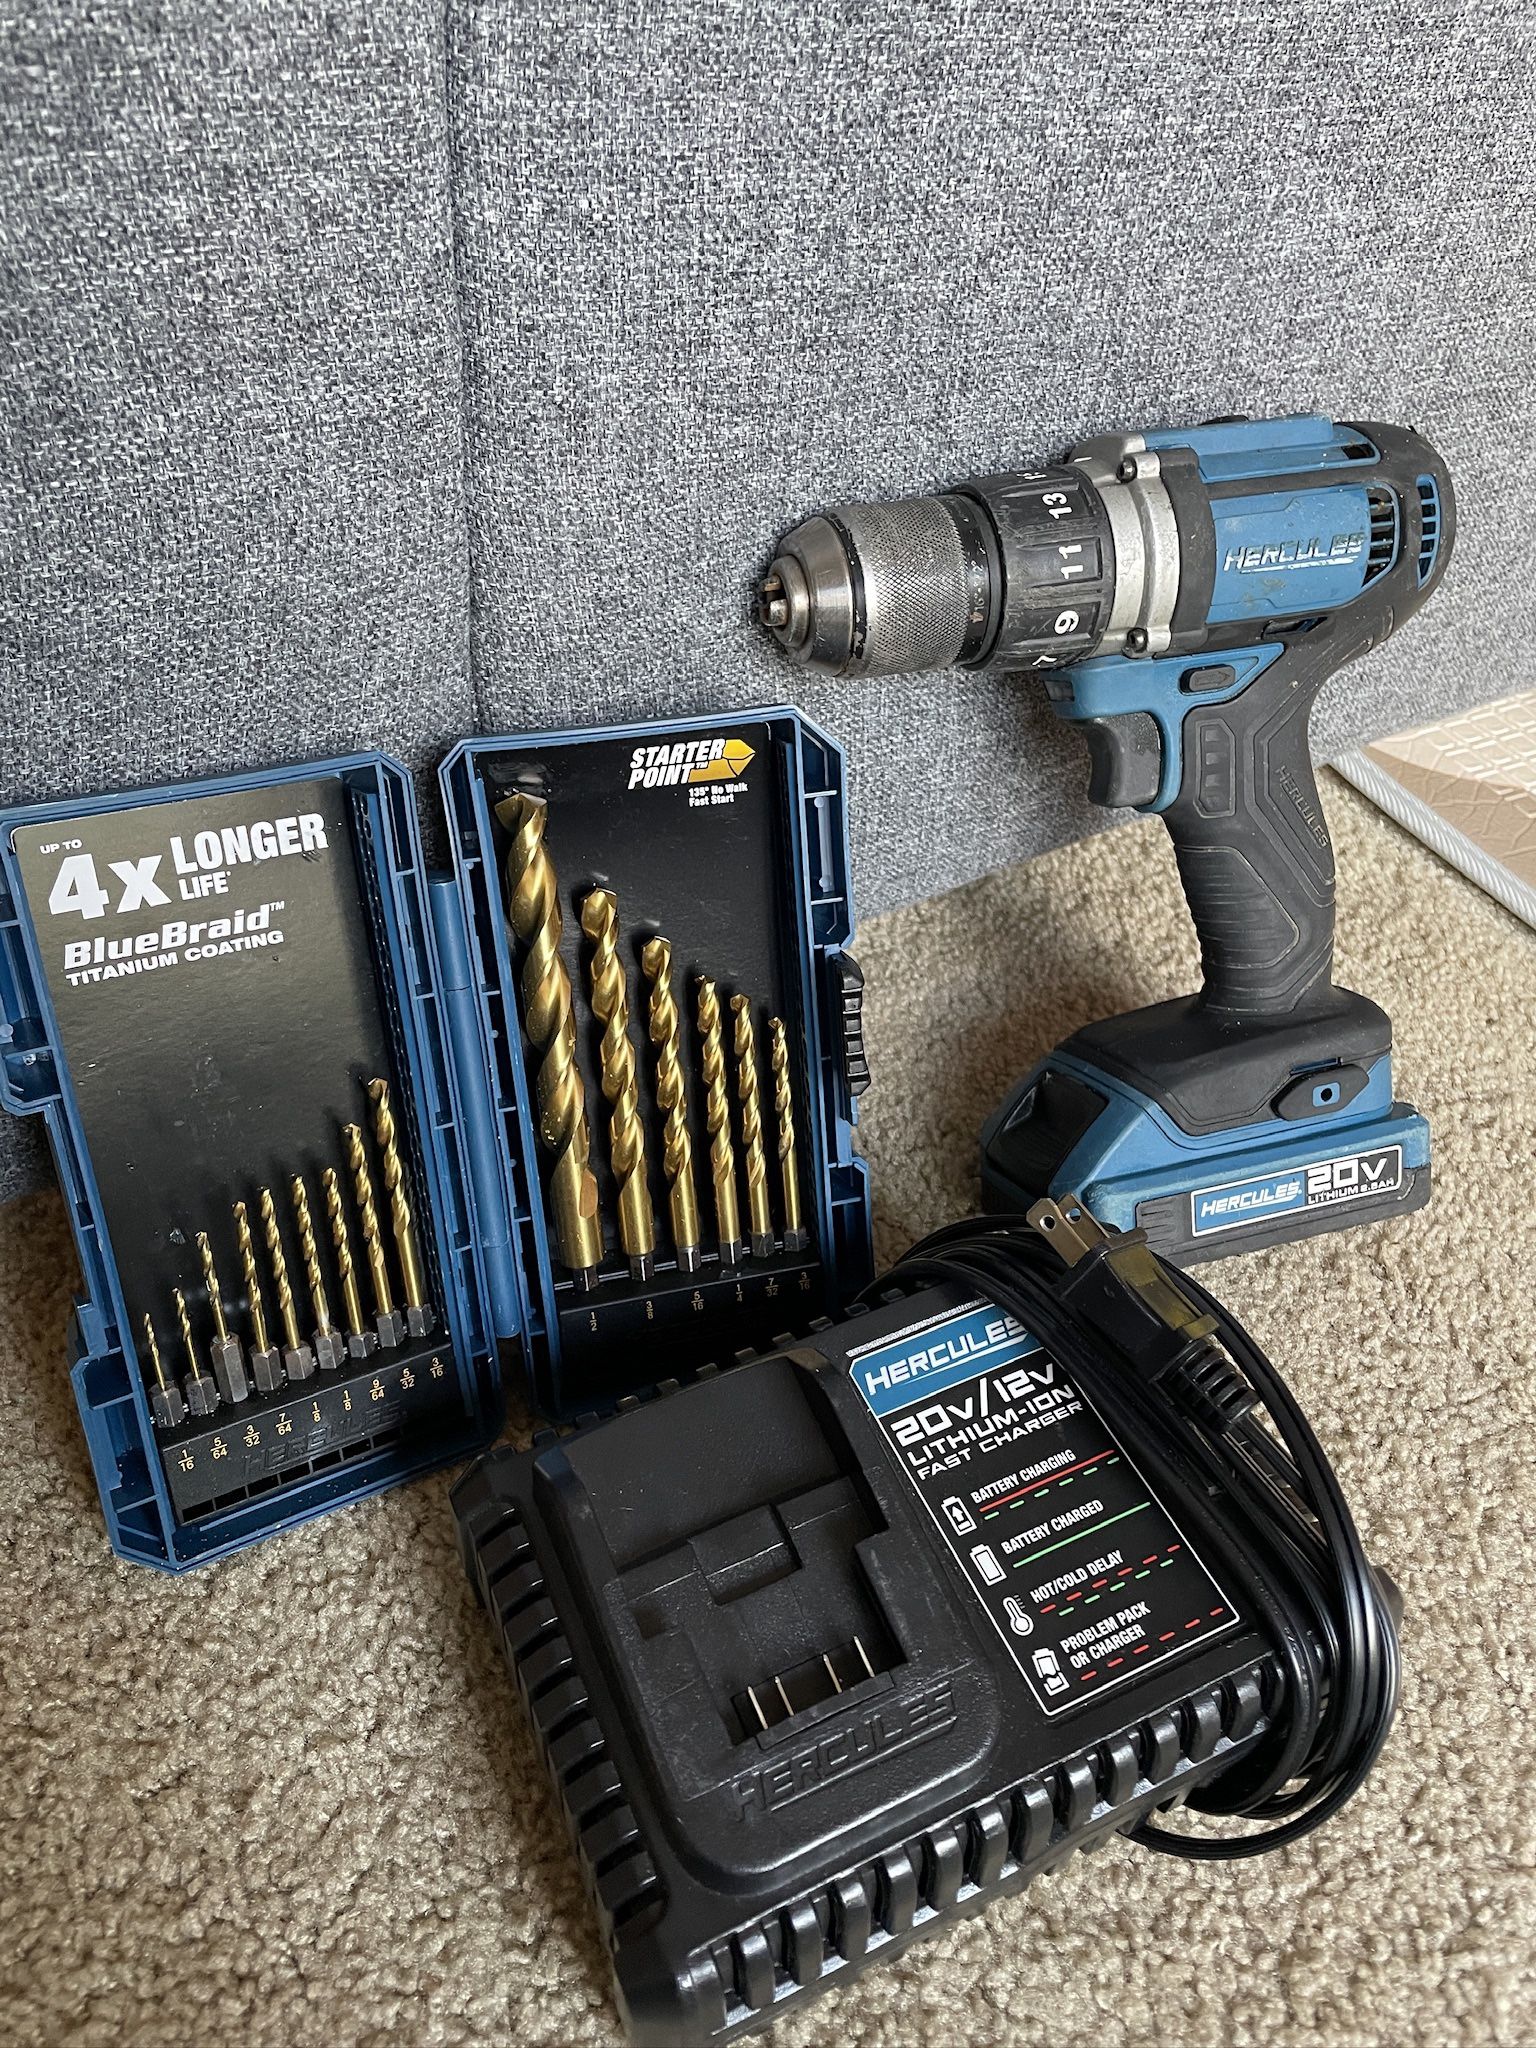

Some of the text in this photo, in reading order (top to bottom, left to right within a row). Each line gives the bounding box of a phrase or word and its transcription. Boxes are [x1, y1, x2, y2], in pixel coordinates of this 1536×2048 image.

[1042, 492, 1073, 519] 13
[1058, 544, 1083, 580] 11
[1223, 532, 1366, 572] HERCULES
[1054, 610, 1079, 635] 9
[630, 738, 725, 769] STARTER
[688, 794, 734, 808] Fast Start
[711, 785, 724, 795] No
[725, 782, 748, 793] Walk
[1275, 765, 1328, 848] HERCULES
[40, 838, 82, 855] UP TO
[169, 812, 329, 875] LONGER
[65, 930, 284, 987] TITANIUM COATING
[1308, 1185, 1359, 1205] LITHIUM
[906, 1384, 1075, 1467] LITHIUM-ION
[916, 1401, 1083, 1480] FAST CHARGER
[970, 1449, 1077, 1504] BATTERY CHARGING
[1000, 1499, 1104, 1554] BATTERY CHARGED
[1029, 1549, 1124, 1604] HOT/COLD DELAY
[1059, 1601, 1151, 1654] PROBLEM PACK
[1069, 1624, 1146, 1669] OR CHARGER
[732, 1681, 956, 1822] HERCULES
